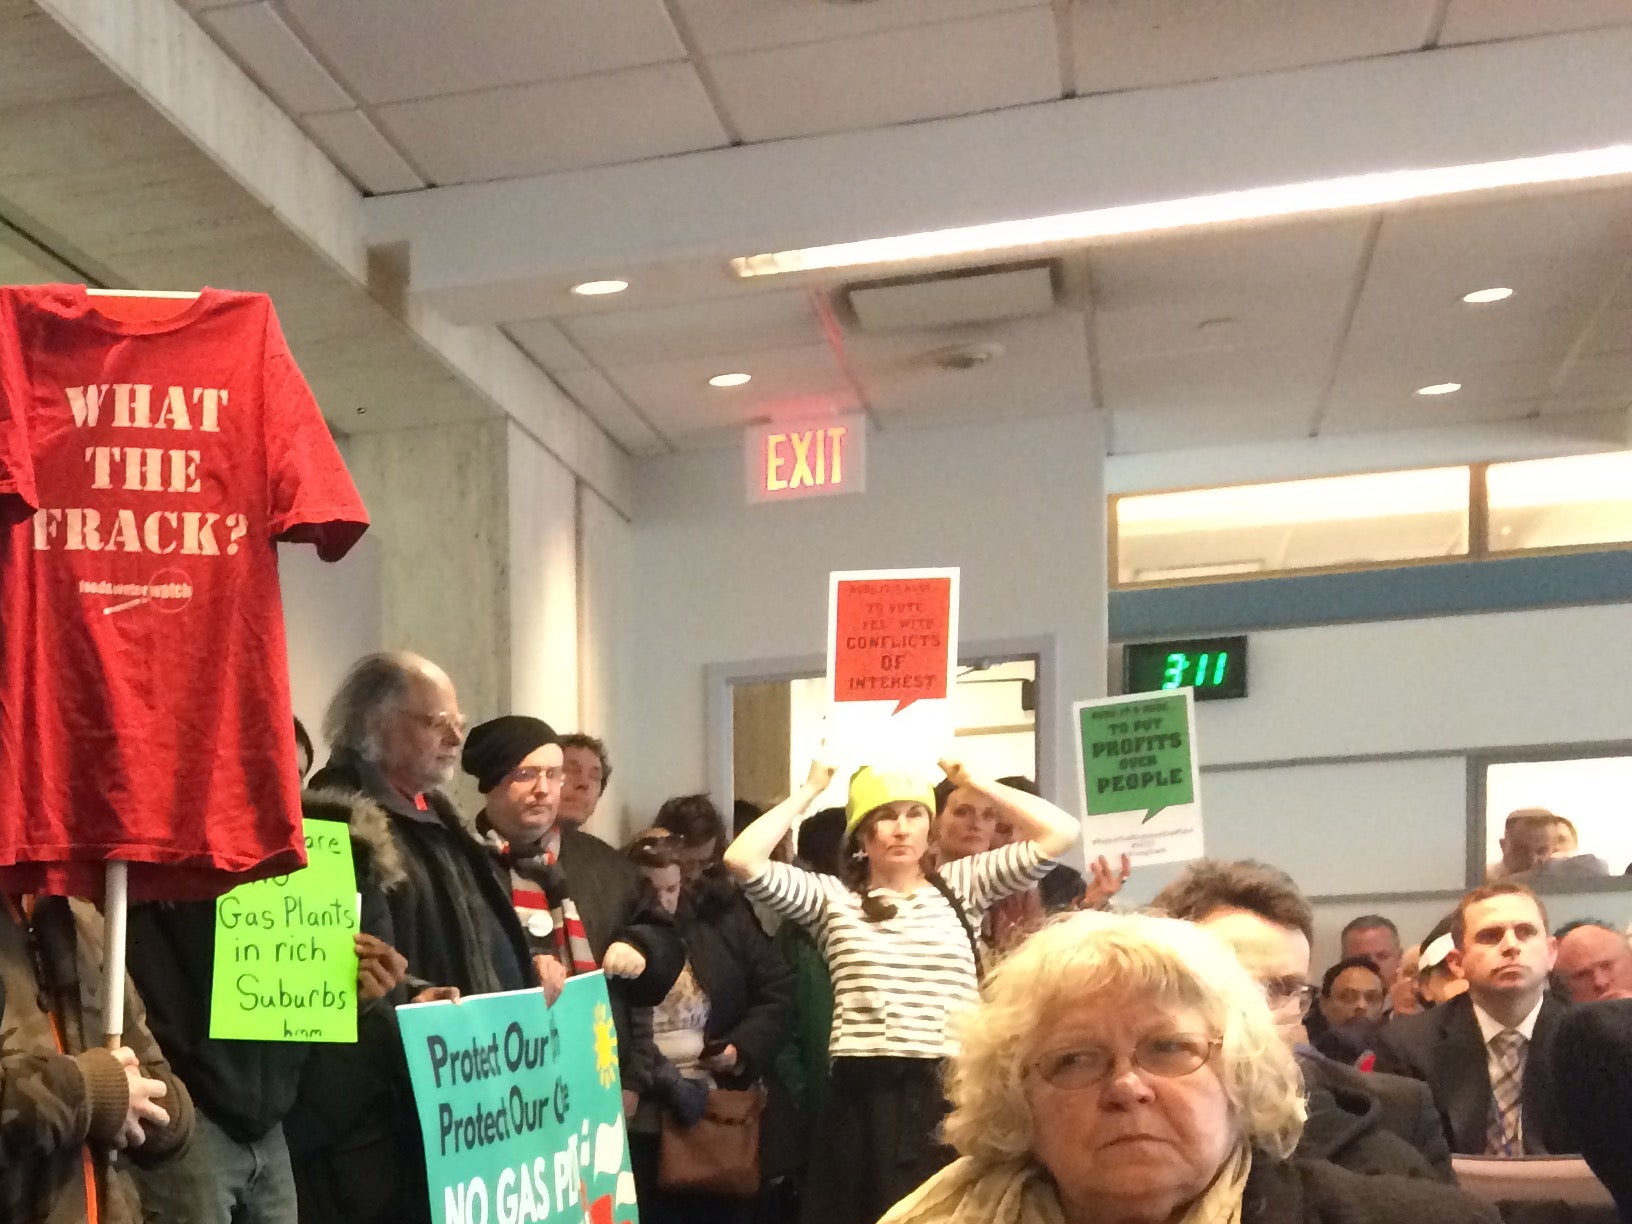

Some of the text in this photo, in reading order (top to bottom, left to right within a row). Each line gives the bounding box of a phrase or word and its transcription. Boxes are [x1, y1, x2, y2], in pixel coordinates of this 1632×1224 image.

[65, 383, 229, 432] WHAT
[85, 446, 201, 493] THE
[767, 427, 847, 491] EXIT
[32, 508, 249, 556] FRACK?
[846, 635, 941, 650] CONFLICTS
[881, 654, 906, 671] OF
[849, 674, 936, 690] INTEREST
[1108, 717, 1162, 735] TO PUT
[1092, 731, 1182, 758] PROFITS
[1119, 754, 1158, 769] OVER
[1097, 768, 1183, 793] PEOPLE
[218, 895, 355, 930] Gas Plants
[235, 934, 326, 962] in rich
[236, 973, 346, 1021] Suburbs
[427, 1032, 501, 1089] Protect
[504, 1021, 549, 1073] Our
[438, 1096, 510, 1157] Protect
[509, 1084, 549, 1136] Our
